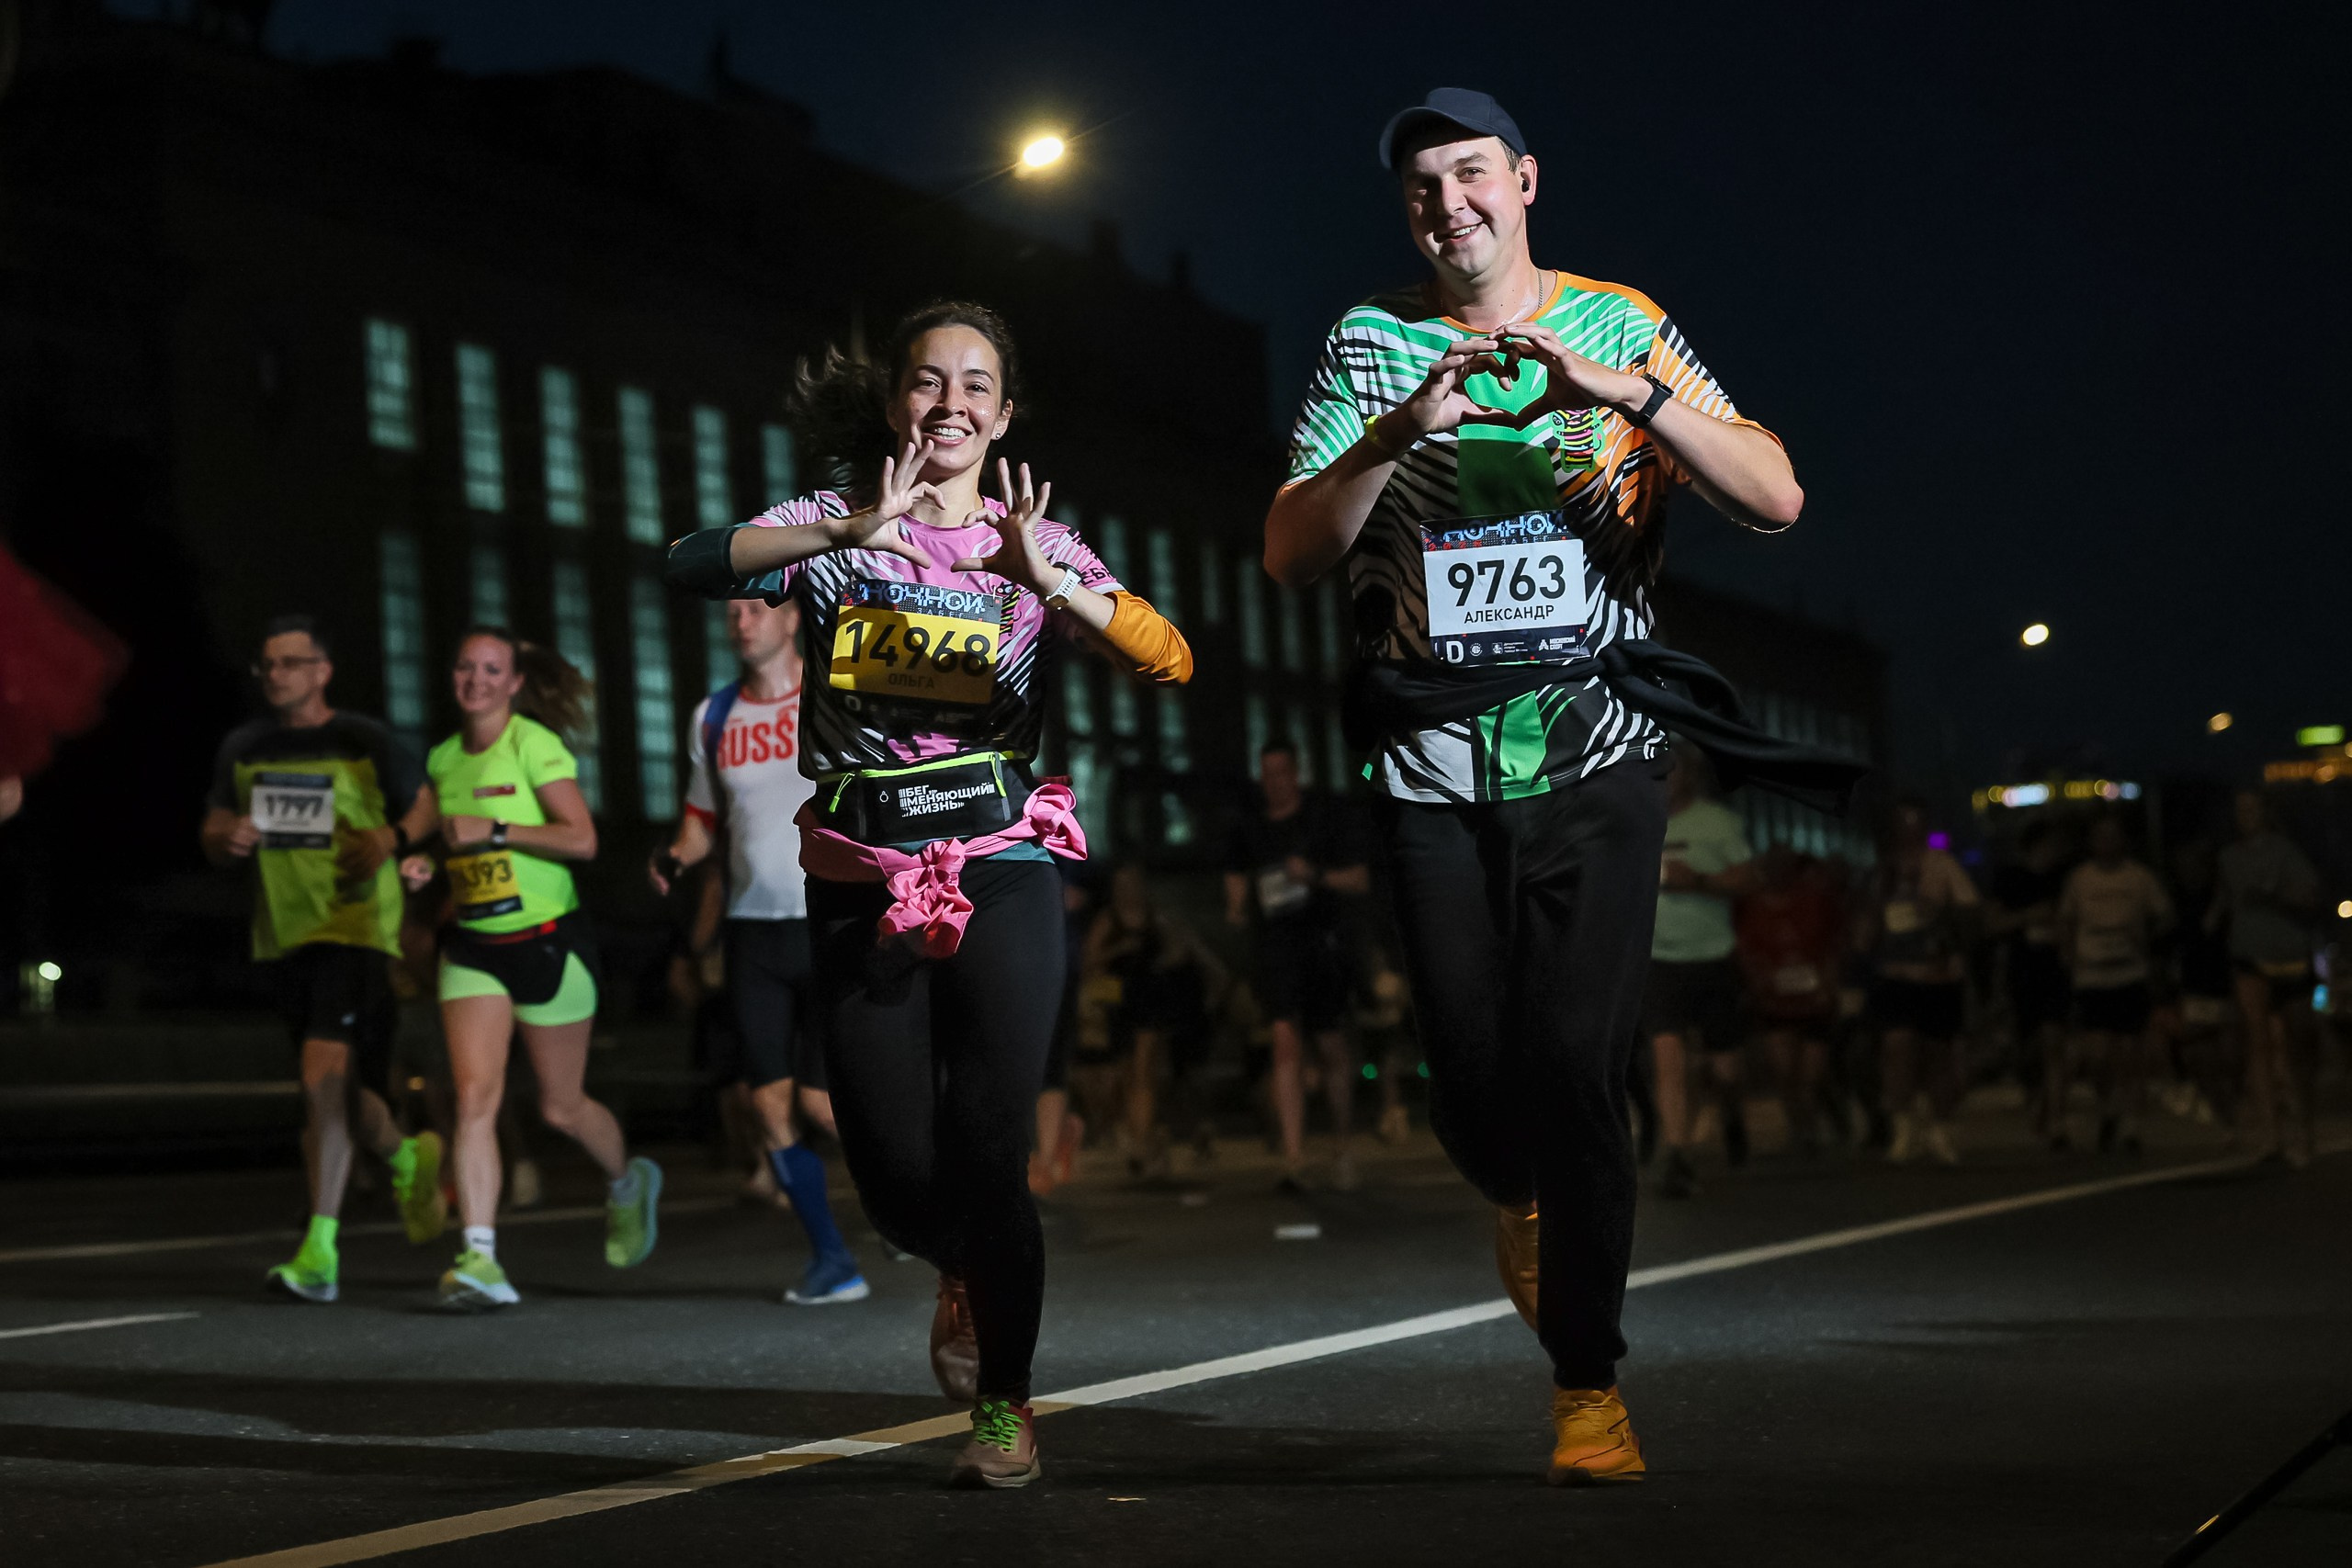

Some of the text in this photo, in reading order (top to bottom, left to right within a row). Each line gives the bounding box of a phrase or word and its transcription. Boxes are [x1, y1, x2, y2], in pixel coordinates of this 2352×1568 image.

[1447, 555, 1566, 607] 9763
[1464, 604, 1555, 625] АЛЕКСАНДР
[844, 619, 991, 677] 14968
[1445, 640, 1464, 664] D
[888, 672, 935, 689] ОЛЬГА
